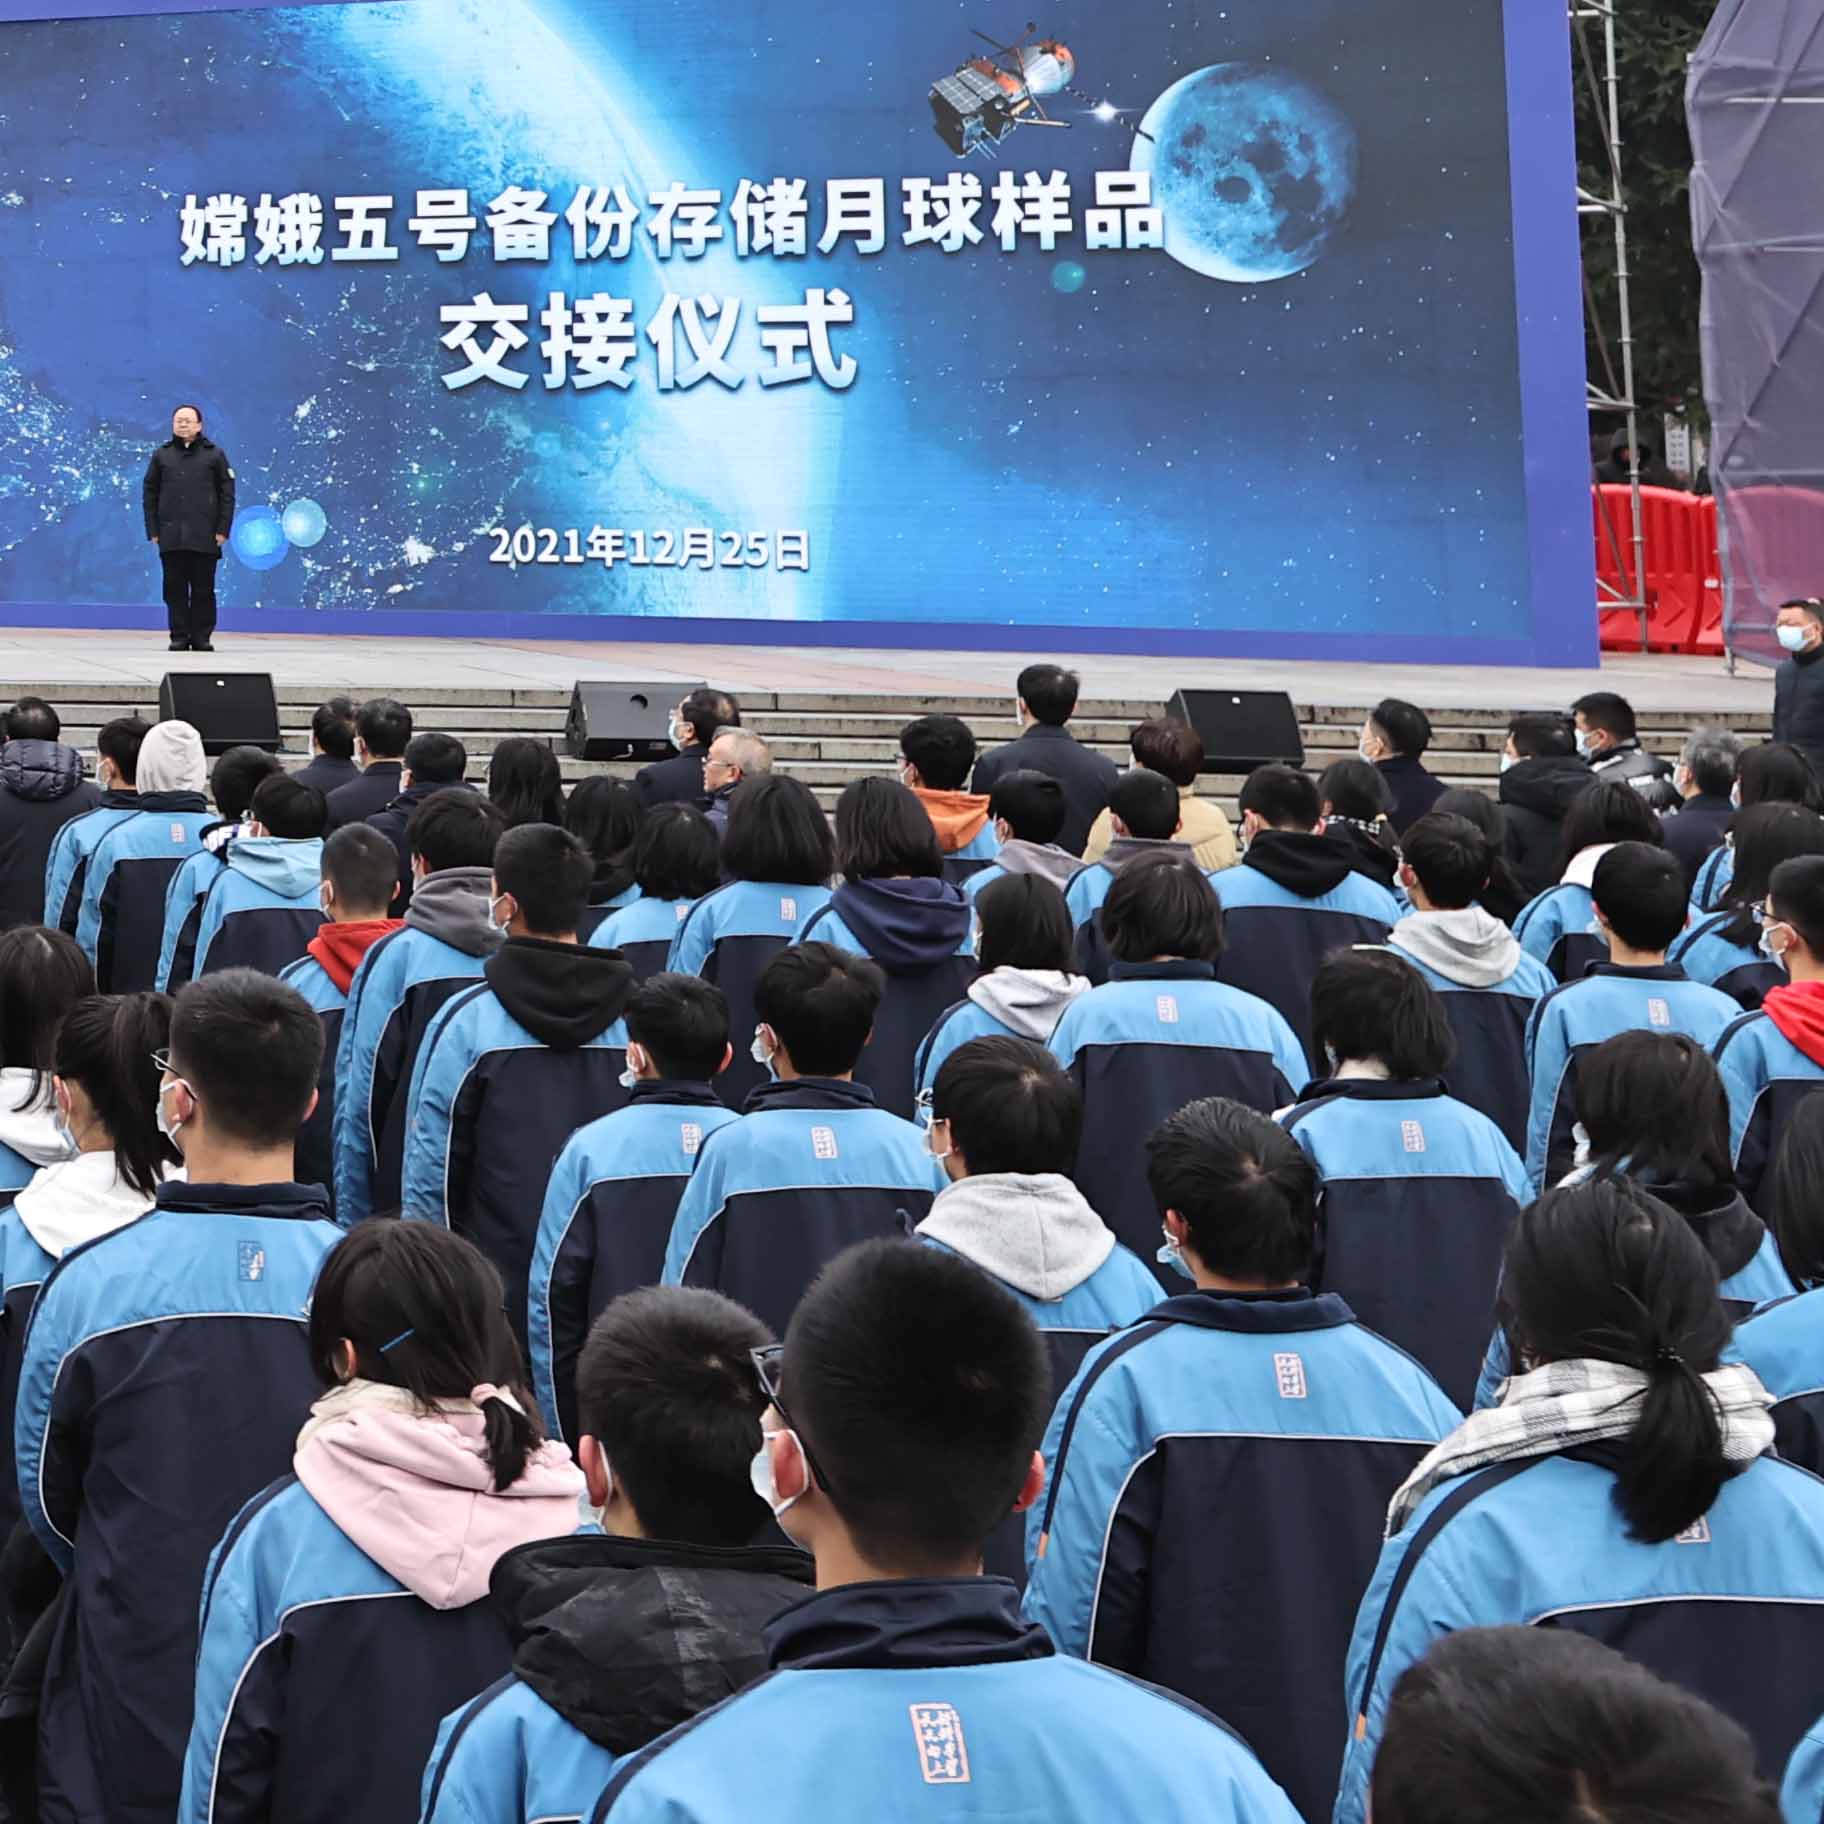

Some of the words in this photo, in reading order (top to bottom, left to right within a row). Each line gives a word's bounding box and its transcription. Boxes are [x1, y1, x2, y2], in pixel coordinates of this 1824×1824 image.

[179, 169, 1165, 267] 嫦娥五号备份存储月球样品
[439, 287, 858, 390] 交接仪式
[488, 523, 811, 571] 2021年12月25日
